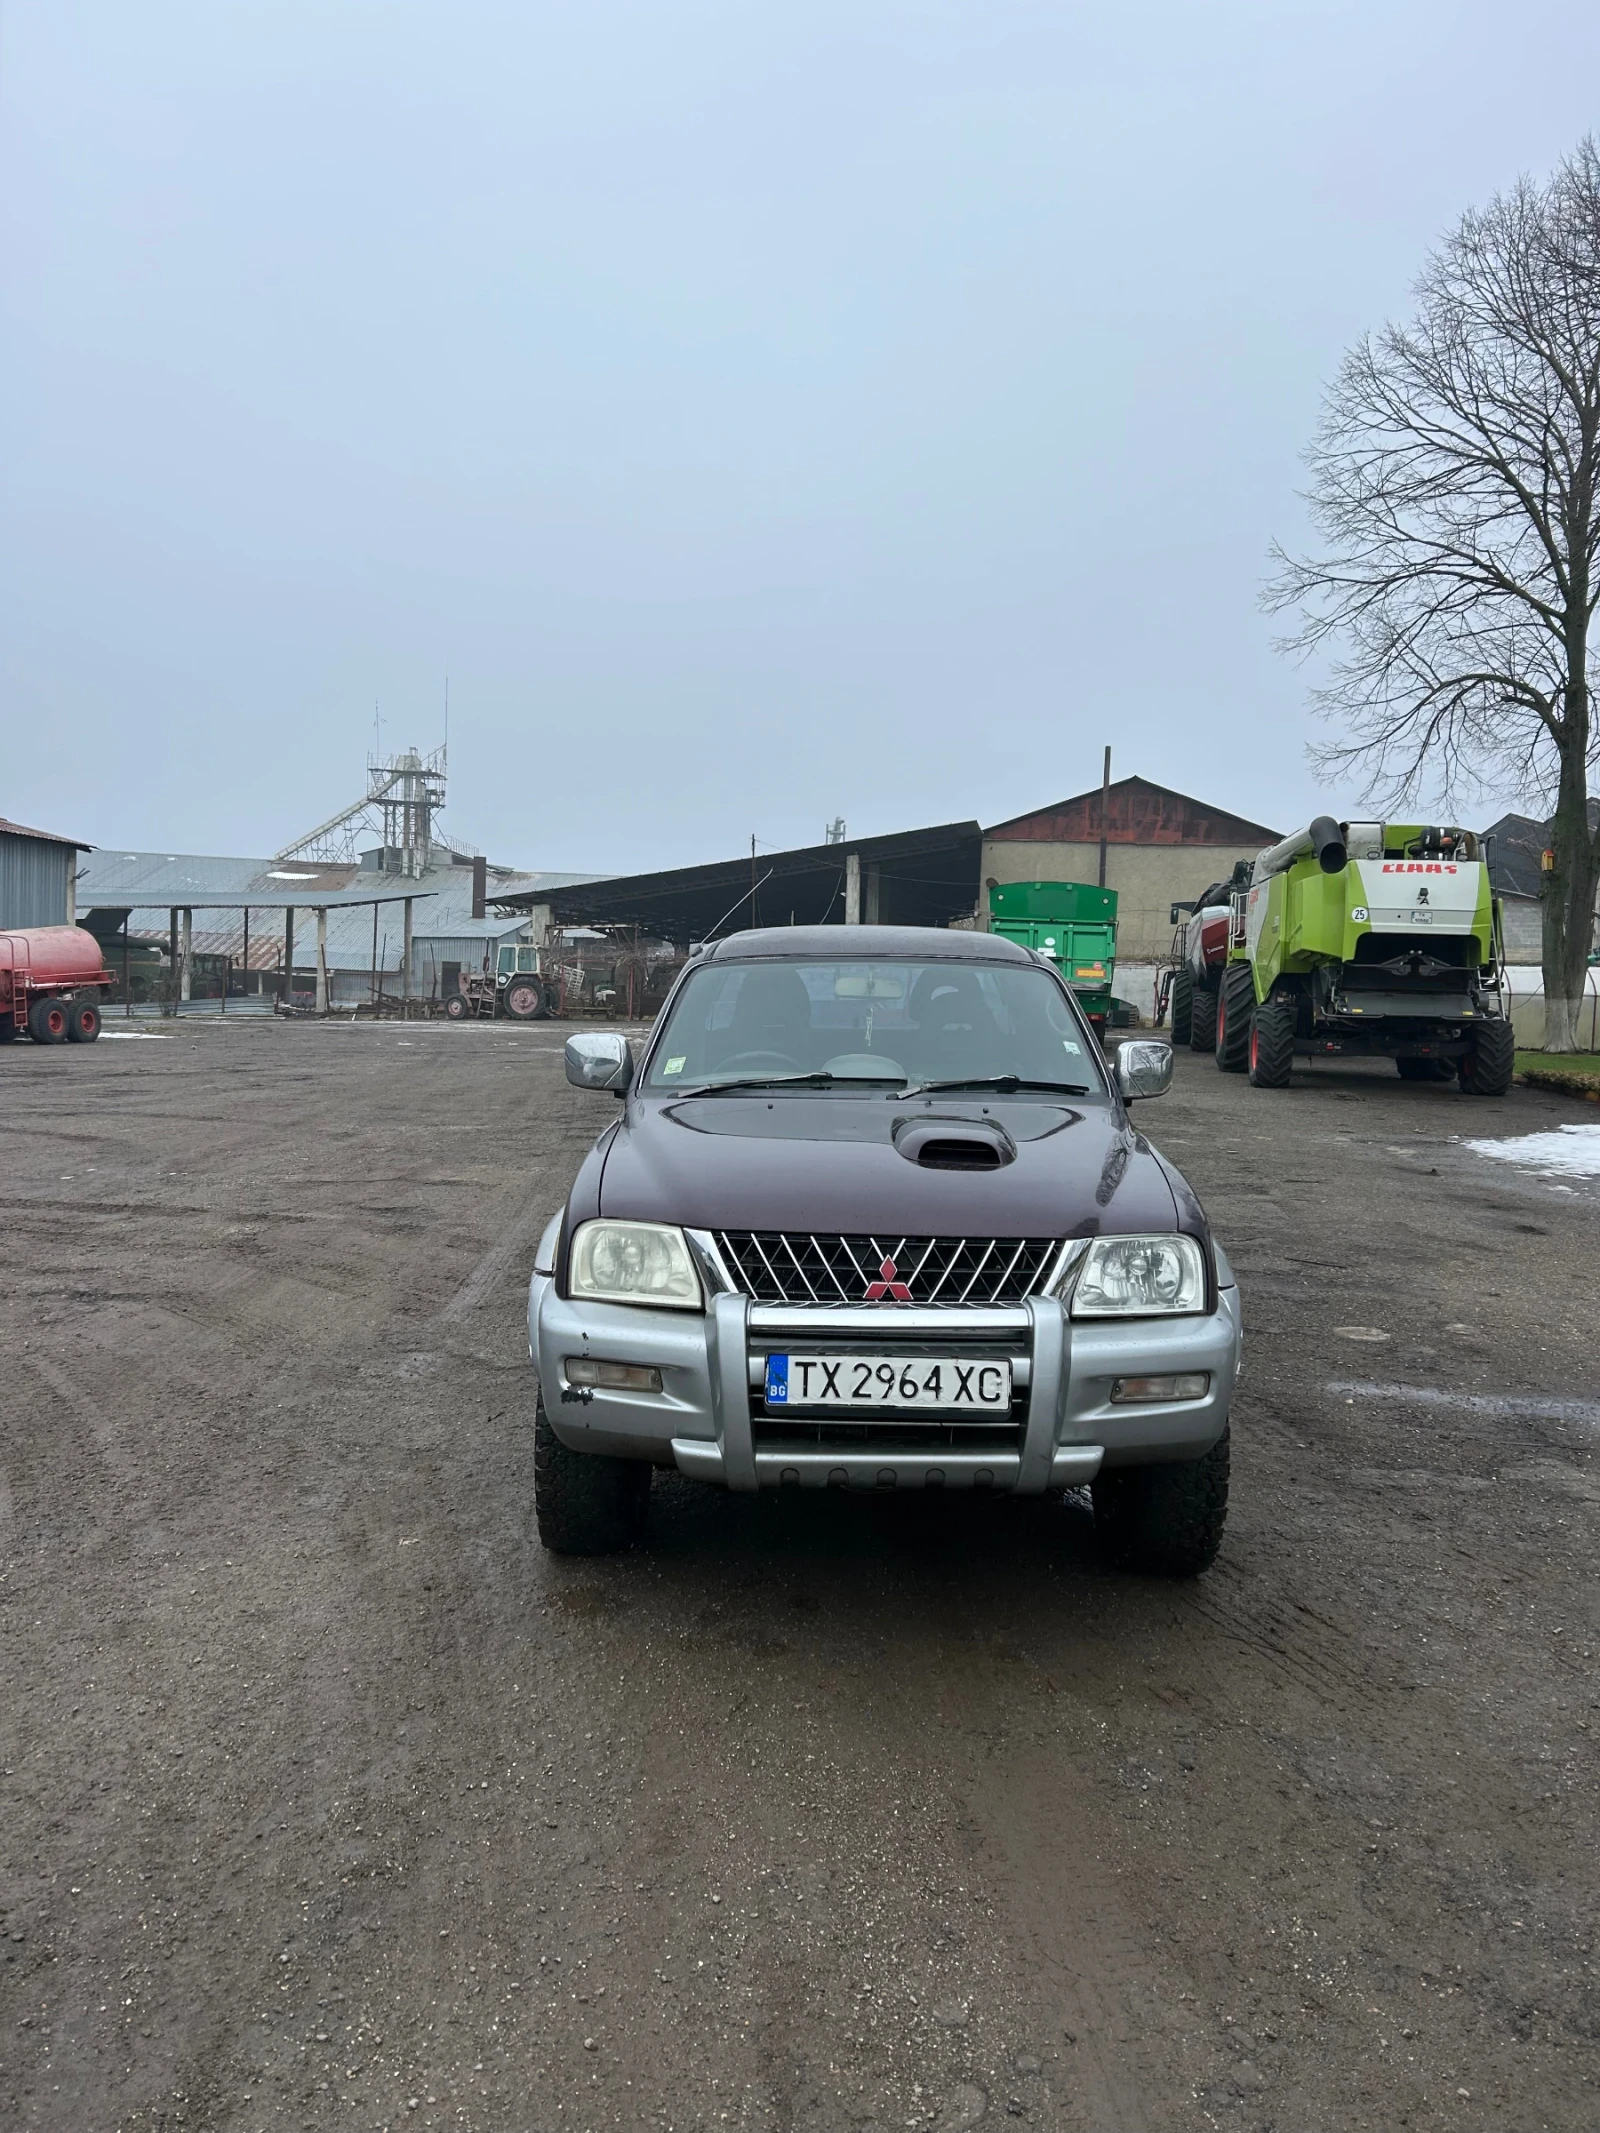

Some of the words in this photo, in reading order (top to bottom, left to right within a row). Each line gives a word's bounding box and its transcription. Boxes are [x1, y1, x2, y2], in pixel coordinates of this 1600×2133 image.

[1382, 863, 1458, 874] CLAAS
[1354, 909, 1365, 920] 25
[795, 1361, 842, 1398] TX
[851, 1362, 943, 1400] 2964
[953, 1366, 1002, 1402] XC
[770, 1385, 786, 1397] BG
